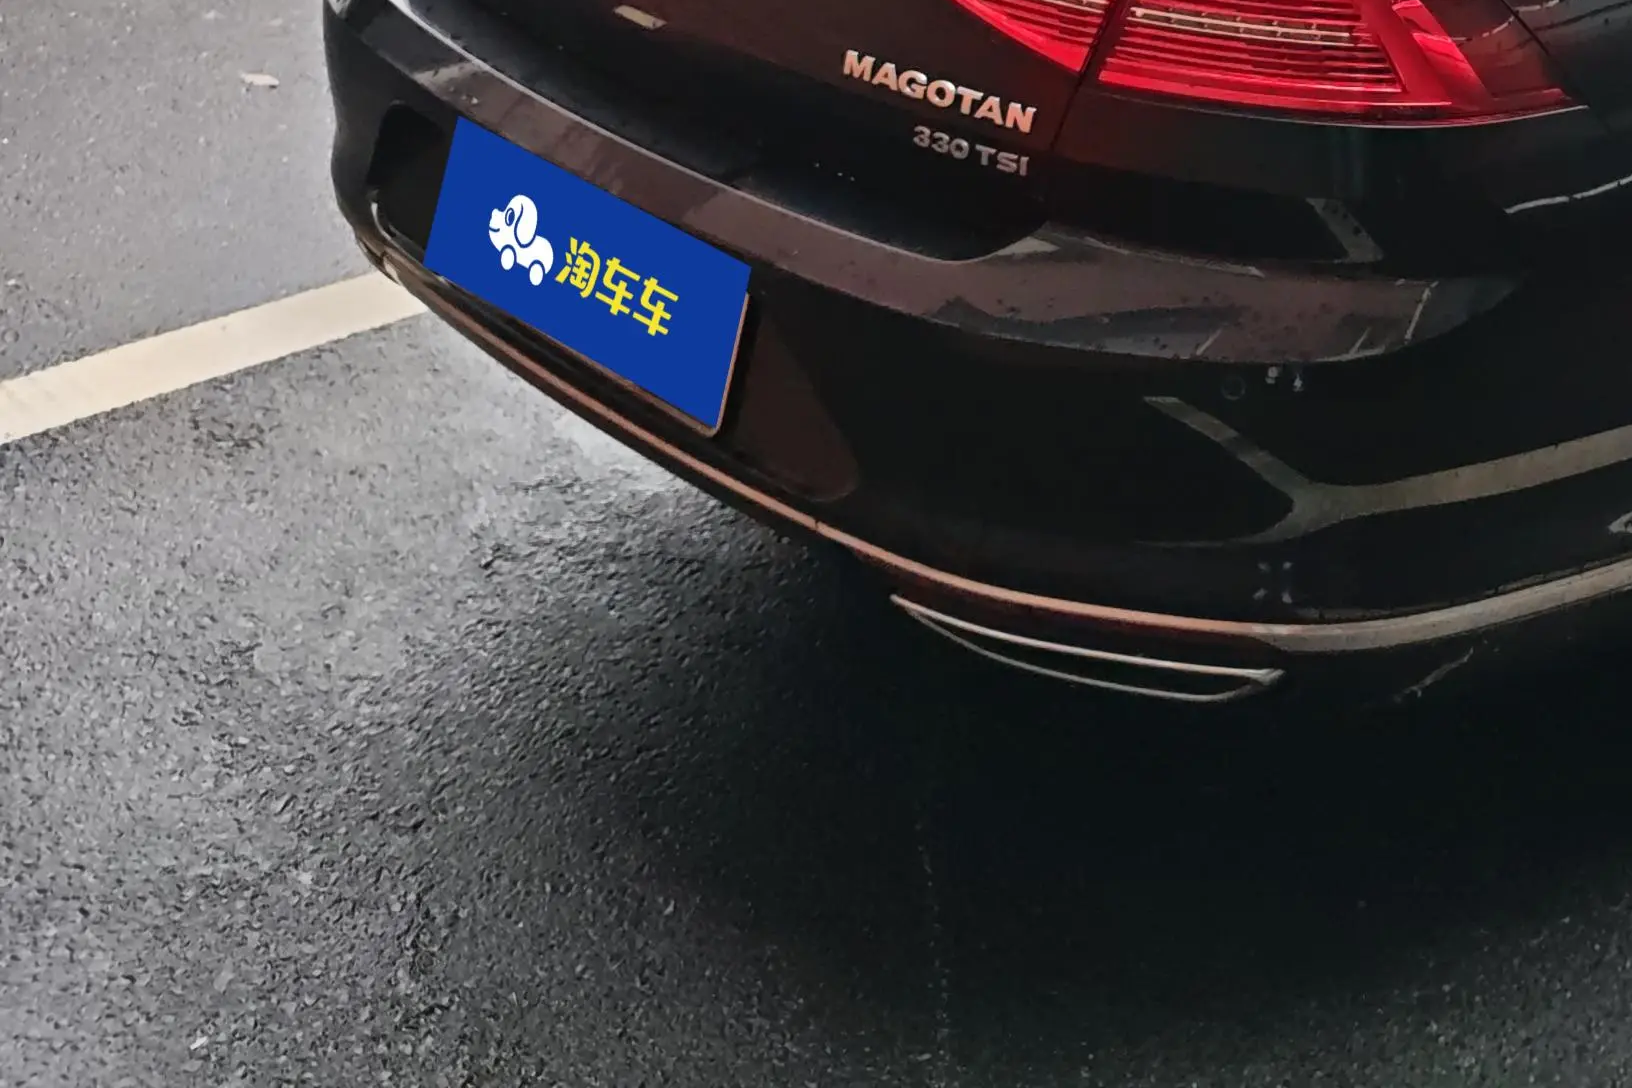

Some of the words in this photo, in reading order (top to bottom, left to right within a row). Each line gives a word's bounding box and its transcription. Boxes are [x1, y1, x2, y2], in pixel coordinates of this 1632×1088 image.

[842, 49, 1038, 134] MAGOTAN
[913, 125, 970, 160] 330
[975, 143, 1030, 177] TSI
